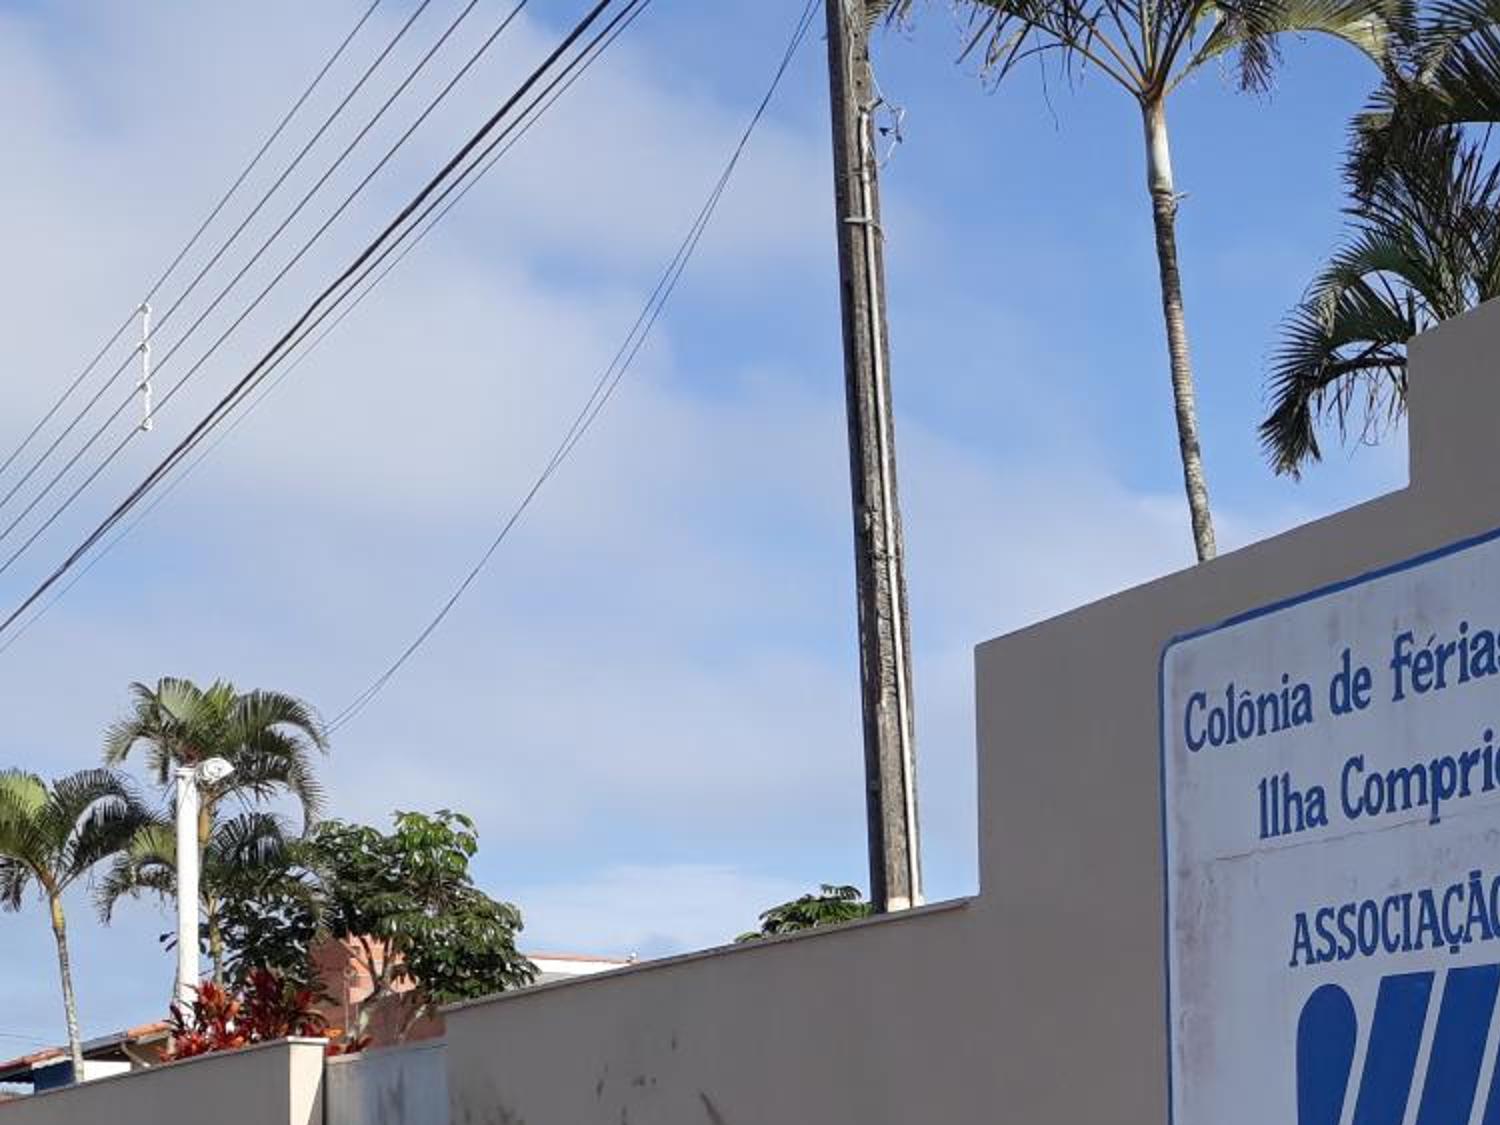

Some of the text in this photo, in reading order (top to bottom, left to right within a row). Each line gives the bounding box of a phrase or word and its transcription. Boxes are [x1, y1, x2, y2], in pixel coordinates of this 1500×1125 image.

[1184, 673, 1313, 753] Colônia
[1329, 648, 1372, 716] de
[1258, 773, 1328, 840] Ilha
